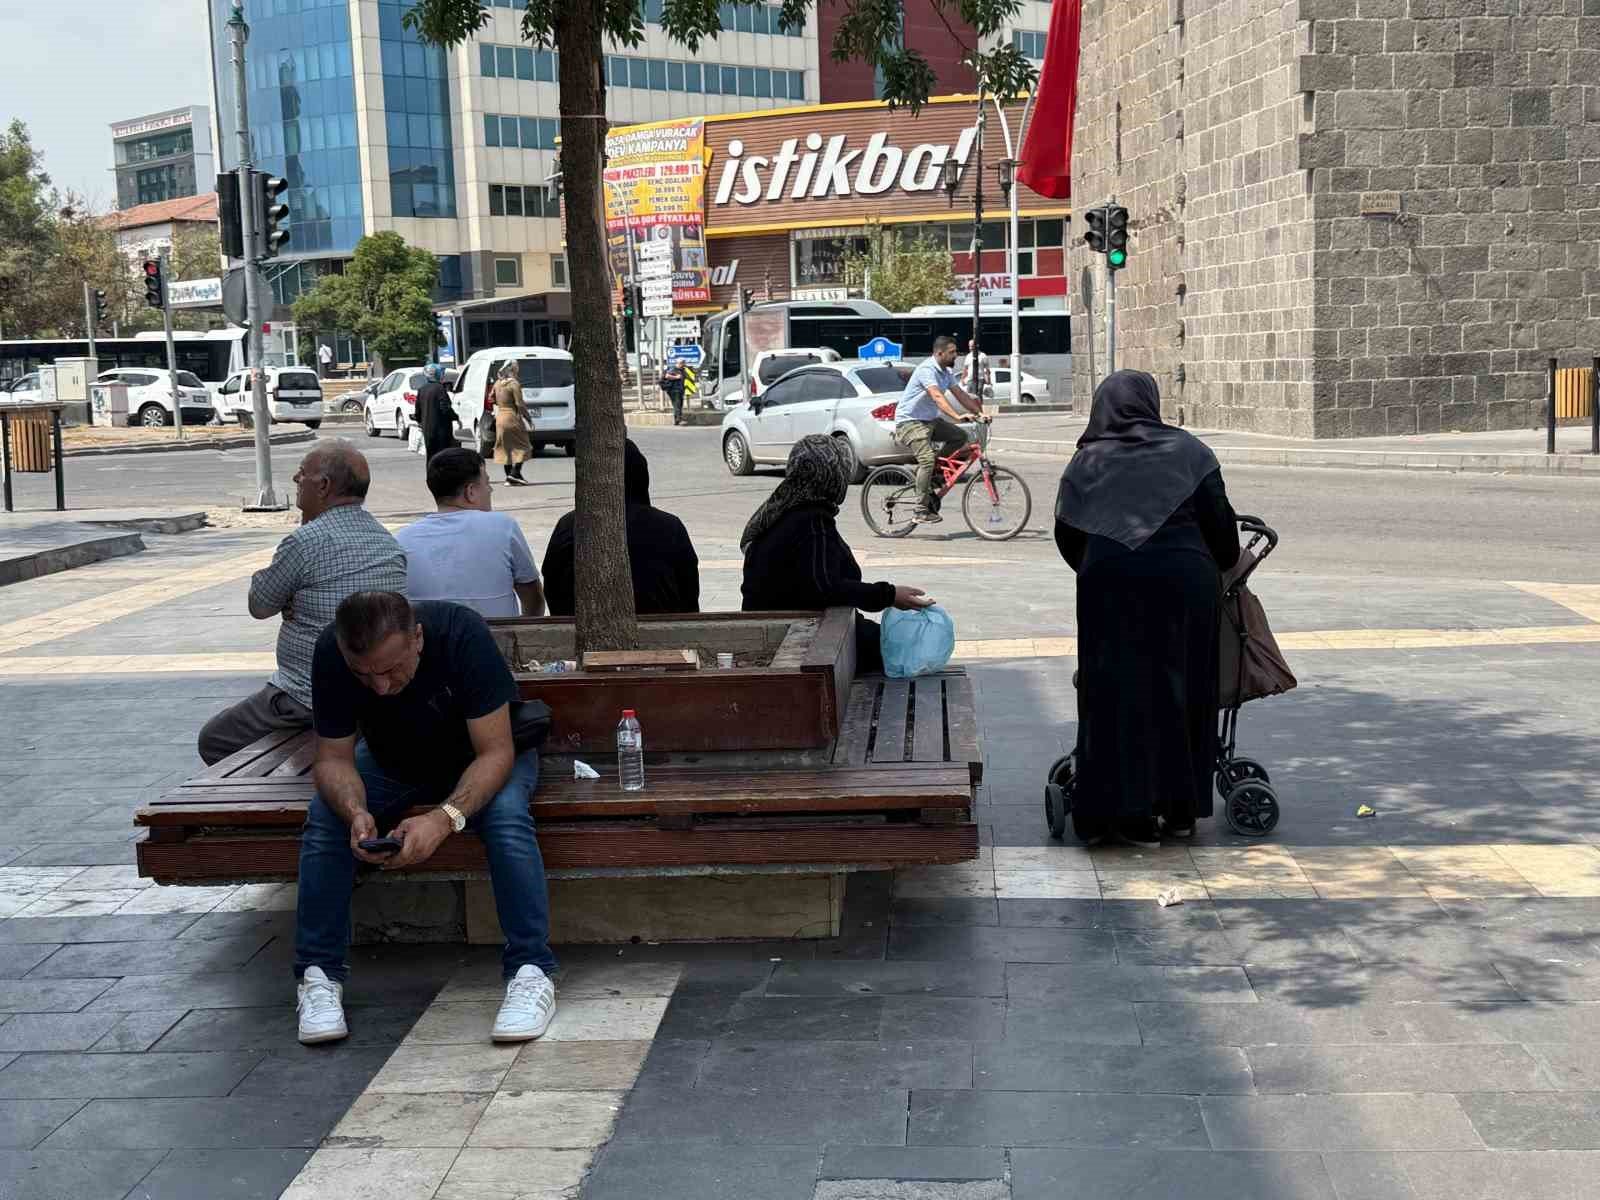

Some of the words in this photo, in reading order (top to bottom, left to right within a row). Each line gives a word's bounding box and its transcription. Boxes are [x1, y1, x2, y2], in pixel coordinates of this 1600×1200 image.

[628, 139, 688, 153] KAMPANYA
[692, 163, 700, 175] TL
[714, 127, 977, 205] istikbal
